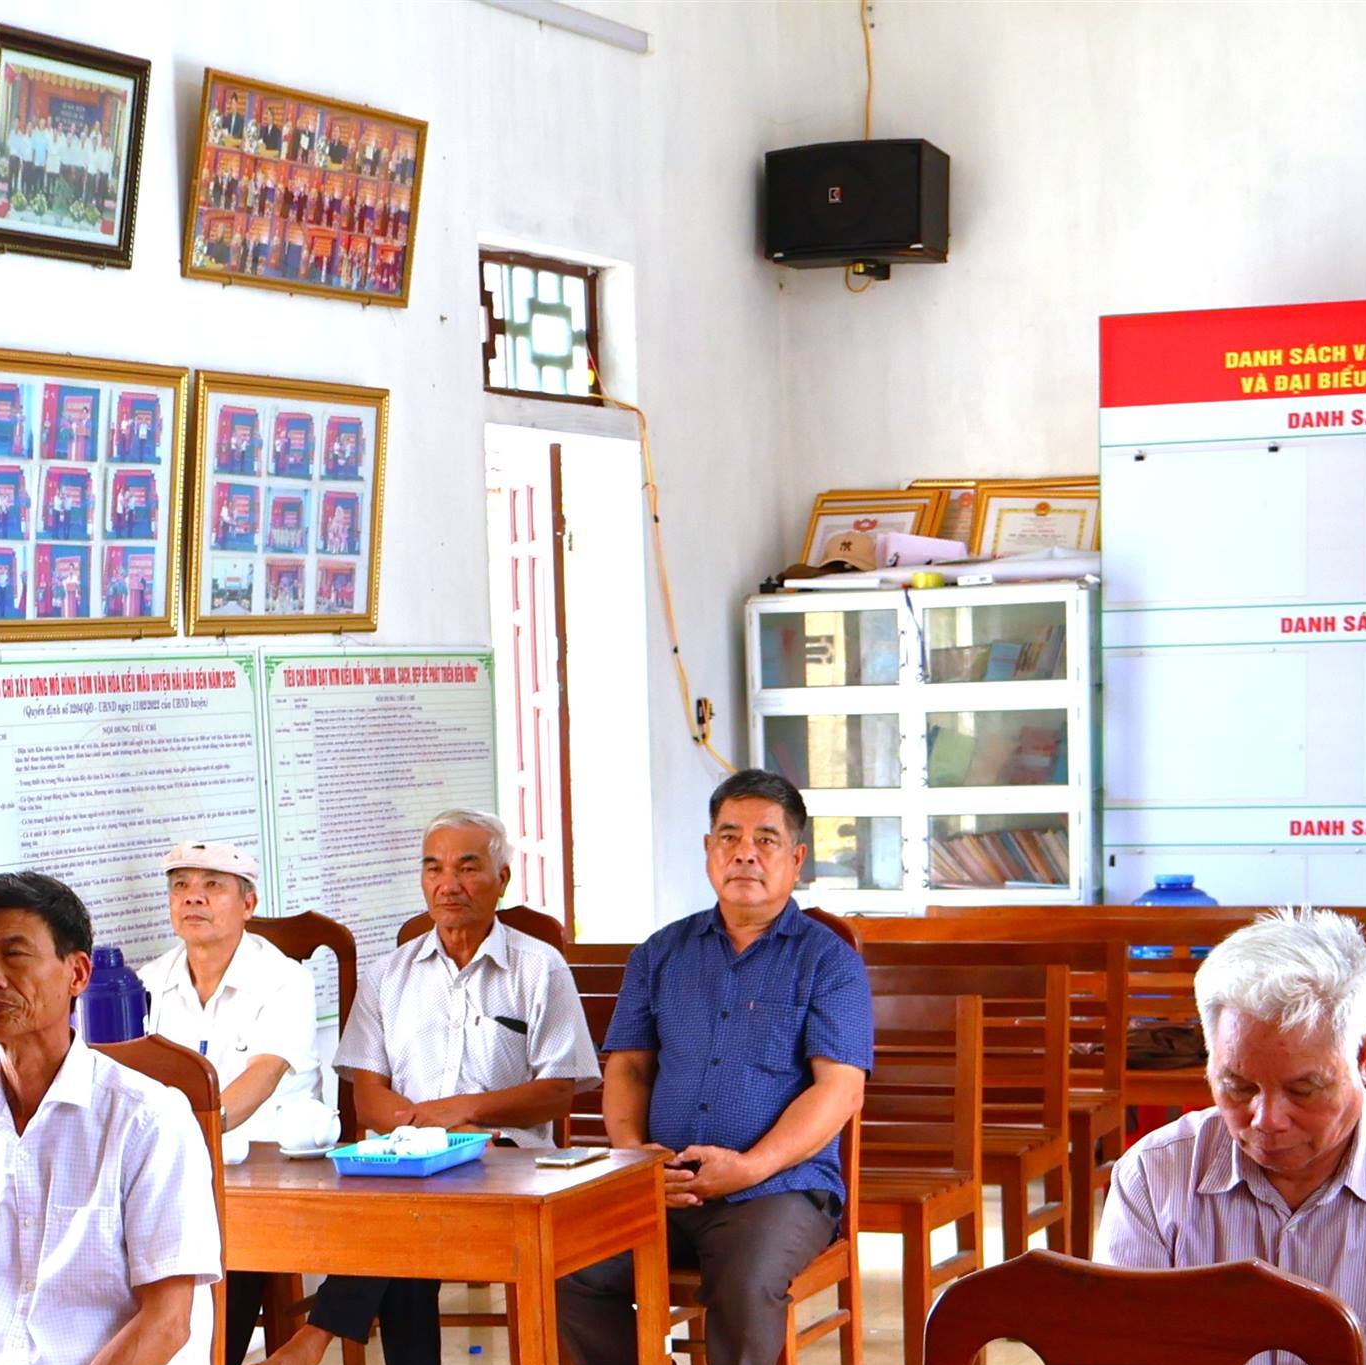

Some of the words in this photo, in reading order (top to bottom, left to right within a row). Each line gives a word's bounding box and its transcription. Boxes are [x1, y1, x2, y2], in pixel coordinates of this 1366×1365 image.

[1225, 348, 1283, 369] DANH
[1289, 344, 1346, 365] SÁCH
[1241, 372, 1268, 393] VÀ
[1275, 373, 1311, 395] ĐẠI
[1318, 364, 1366, 389] BIỂU
[1288, 409, 1343, 429] DANH
[1280, 616, 1336, 634] DANH
[151, 669, 171, 695] HUYỆN
[222, 671, 236, 688] 2025
[1290, 819, 1344, 836] DANH
